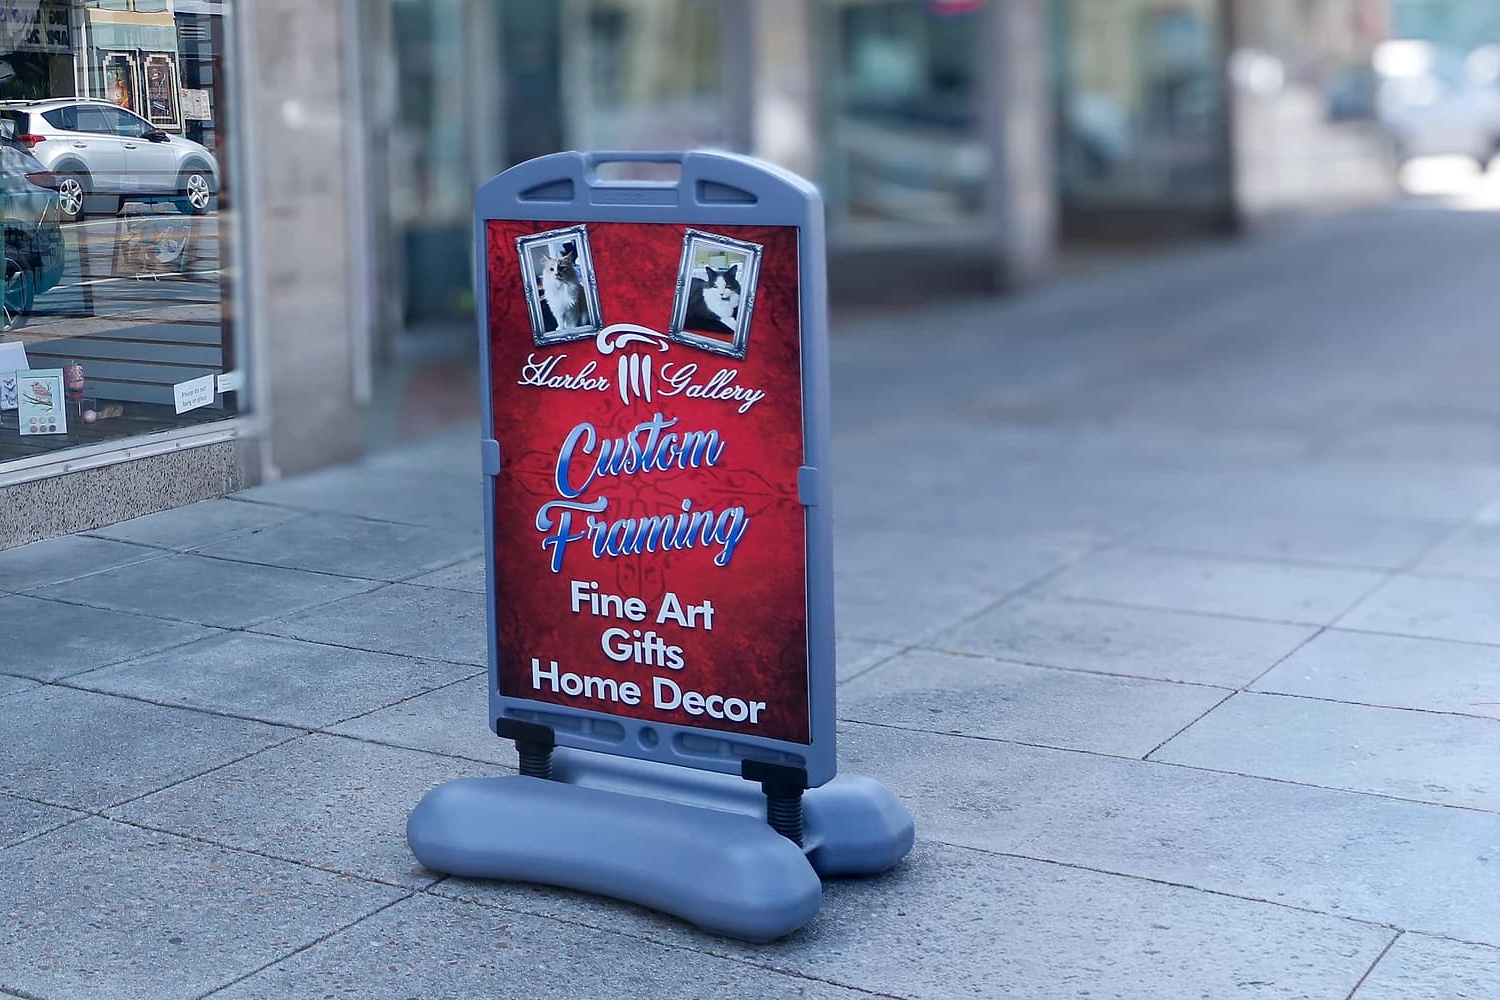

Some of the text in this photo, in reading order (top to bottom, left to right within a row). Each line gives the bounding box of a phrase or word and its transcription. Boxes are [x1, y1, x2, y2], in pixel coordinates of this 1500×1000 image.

[517, 353, 765, 413] Harbor Gallery
[555, 412, 726, 498] Custom
[535, 496, 750, 573] Framing
[570, 580, 715, 630] Fine Art
[601, 627, 685, 670] Gifts
[531, 658, 767, 725] Home Decor
